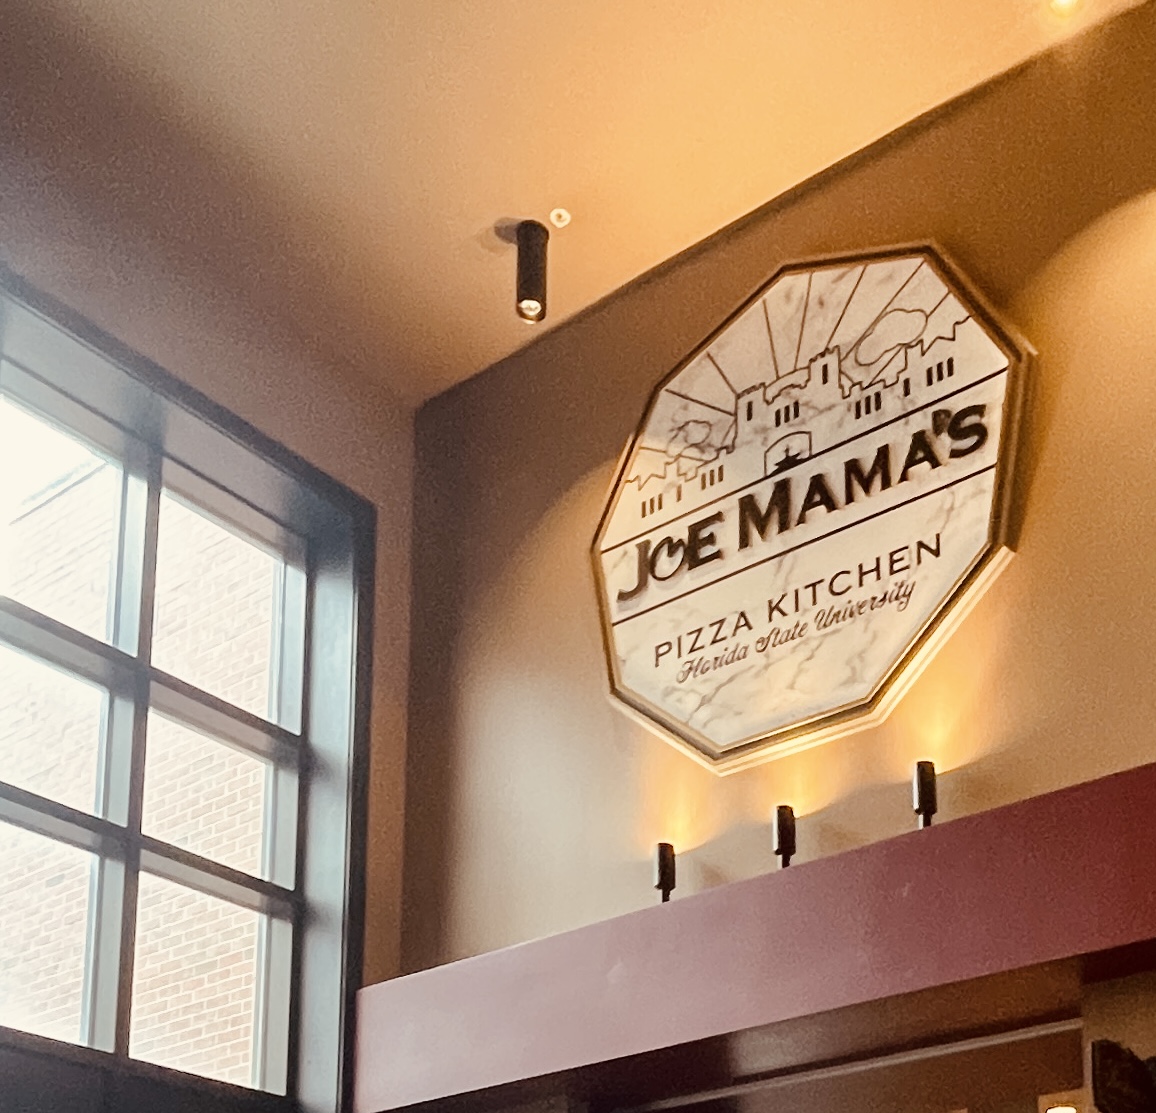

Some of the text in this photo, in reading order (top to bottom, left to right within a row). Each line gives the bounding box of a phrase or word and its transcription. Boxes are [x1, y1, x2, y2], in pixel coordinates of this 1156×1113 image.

[617, 404, 988, 601] JOE MAMA'S
[654, 533, 941, 667] PIZZA KITCHEN
[676, 579, 916, 684] Florida State University
